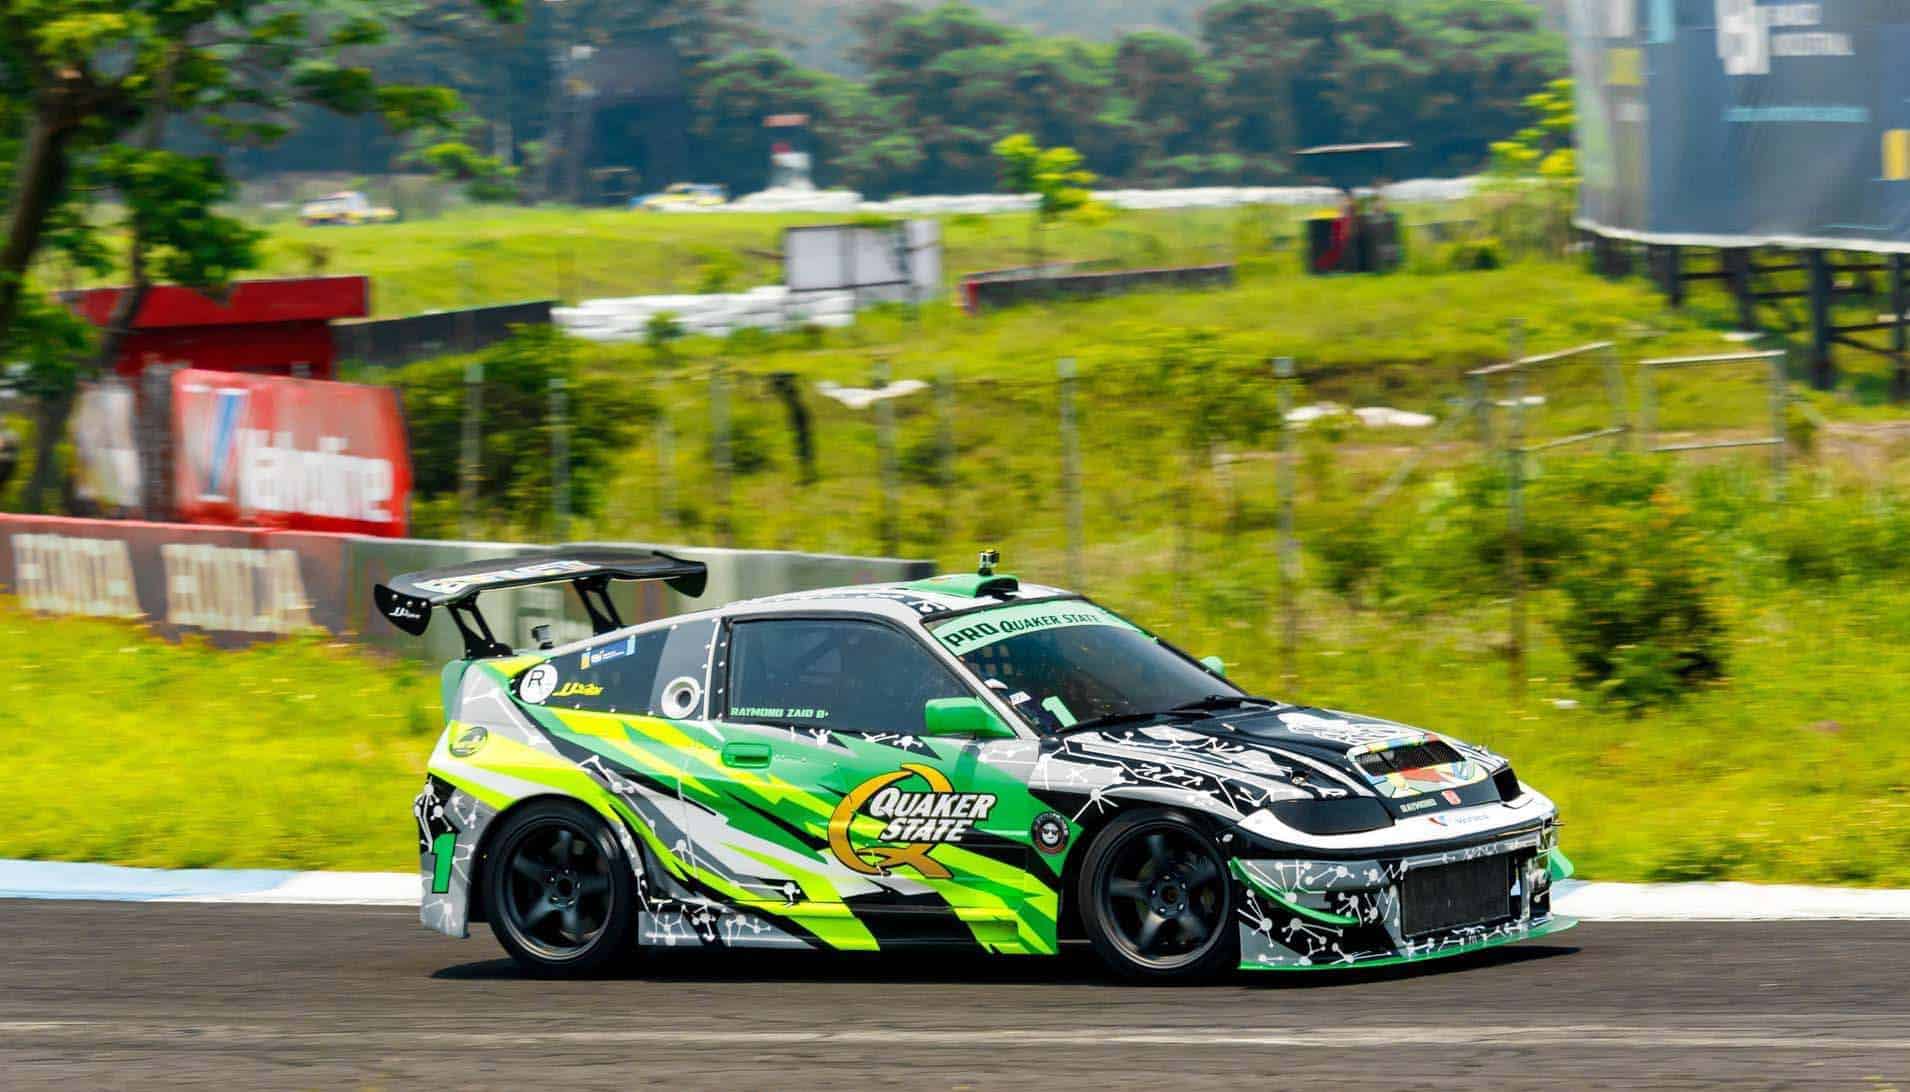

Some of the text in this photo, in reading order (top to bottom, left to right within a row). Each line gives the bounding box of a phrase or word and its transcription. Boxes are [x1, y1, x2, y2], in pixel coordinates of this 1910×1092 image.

[943, 622, 1000, 647] PRO
[1000, 614, 1062, 633] QUAKER
[528, 669, 546, 689] R
[730, 707, 785, 718] RAYMOND
[786, 708, 815, 718] ZAID
[1041, 695, 1078, 728] 1
[869, 787, 997, 819] QUAKER
[880, 817, 974, 842] STATE
[431, 832, 458, 894] 1
